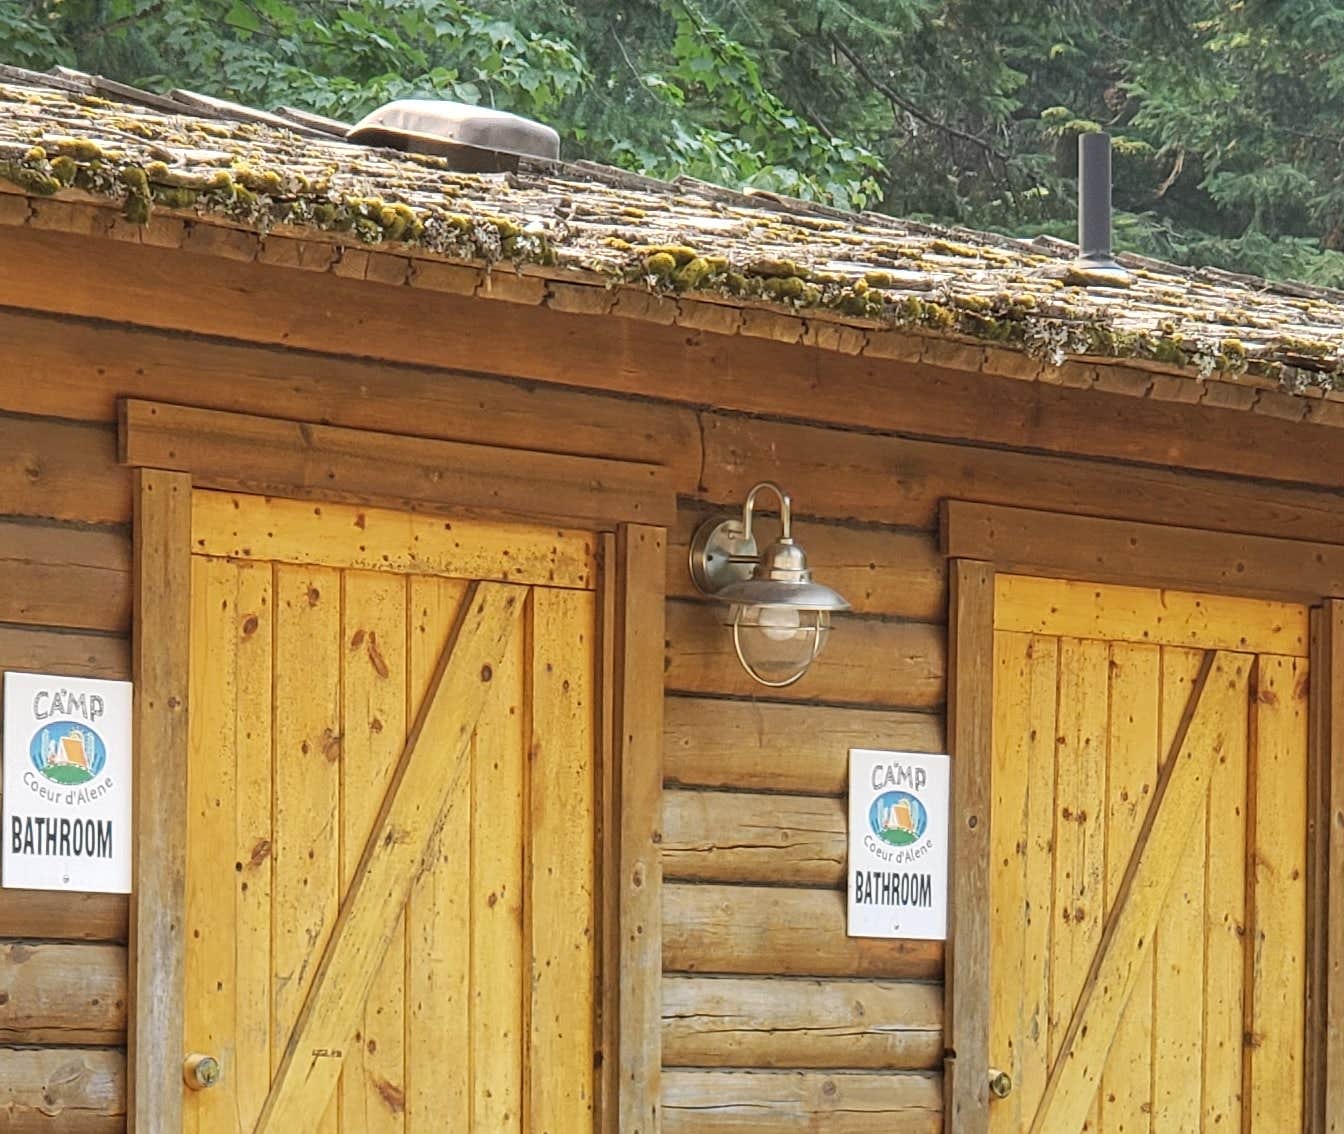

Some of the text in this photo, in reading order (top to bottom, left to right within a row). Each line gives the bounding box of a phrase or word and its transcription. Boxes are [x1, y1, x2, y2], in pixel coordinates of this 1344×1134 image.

[33, 689, 104, 722] CAMP
[23, 771, 61, 804] Coeur
[872, 763, 926, 791] CAMP
[12, 816, 112, 859] BATHROOM
[863, 835, 893, 862] Coeur
[856, 871, 931, 907] BATHROOM
